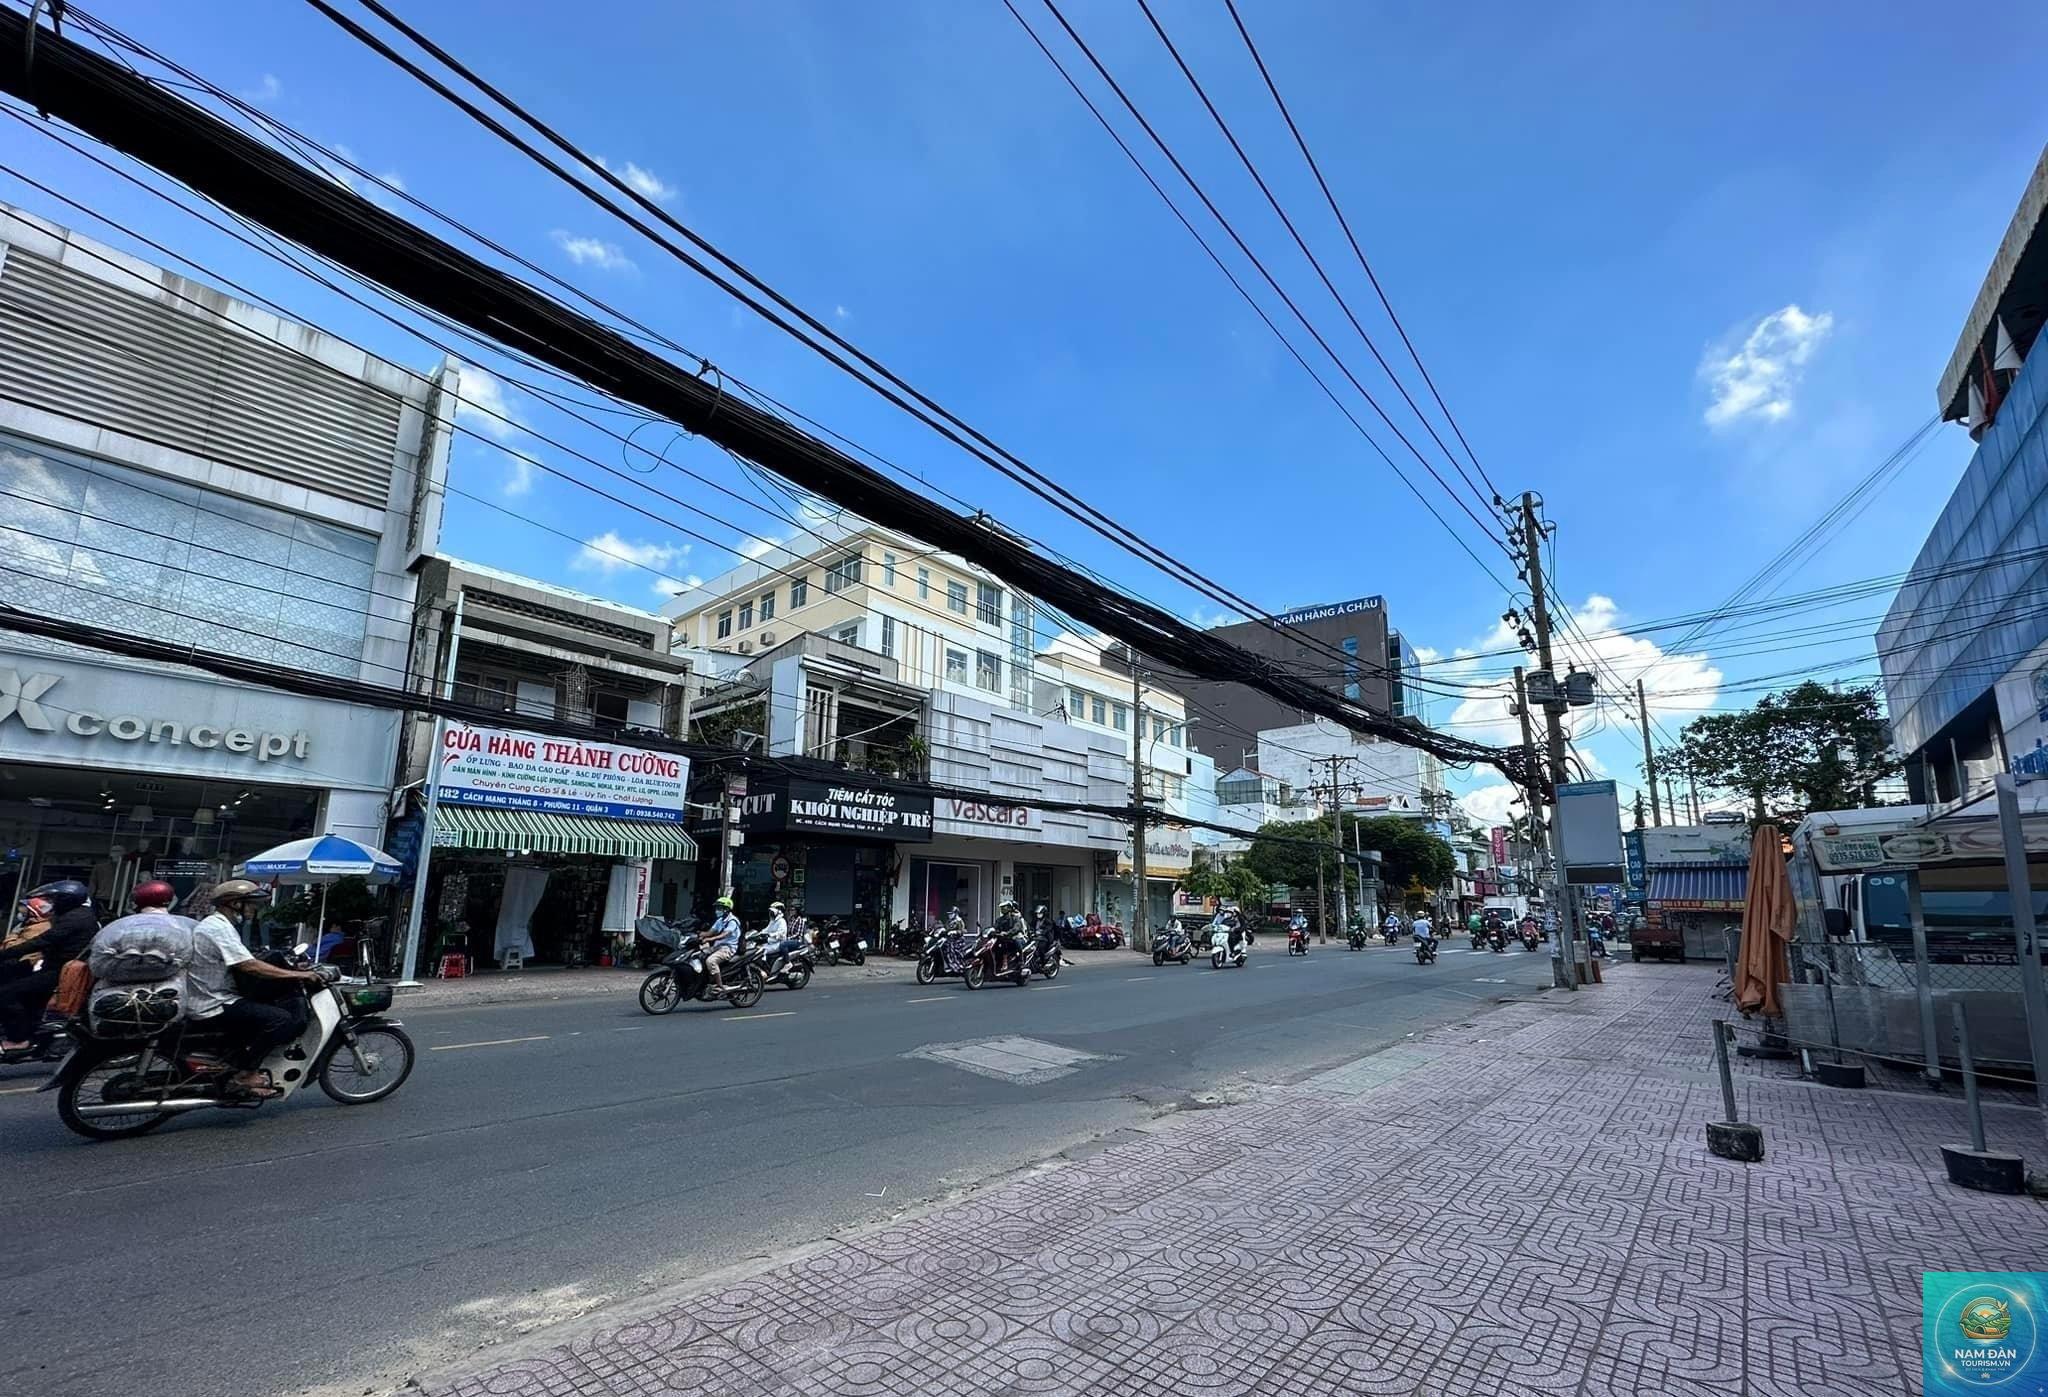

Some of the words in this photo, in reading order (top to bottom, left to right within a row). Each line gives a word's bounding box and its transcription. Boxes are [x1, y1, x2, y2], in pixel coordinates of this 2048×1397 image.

[1305, 607, 1335, 621] HÀNG
[1337, 604, 1345, 616] Á
[1346, 599, 1379, 613] CHÂU
[66, 710, 311, 762] concept
[444, 724, 481, 752] CỬA
[487, 733, 537, 760] HÀNG
[543, 741, 614, 769] THÀNH
[618, 752, 680, 778] CƯỜNG
[508, 761, 524, 770] BAO
[525, 764, 537, 772] DA
[538, 764, 553, 774] CAO
[555, 765, 570, 776] CẤP
[645, 778, 681, 789] BLUETOOTH
[462, 791, 484, 802] CÁCH
[485, 795, 506, 805] MẠNG
[508, 796, 531, 807] THÁNG
[472, 778, 507, 789] Chuyên
[508, 783, 531, 793] Cung
[585, 791, 594, 799] Uy
[828, 787, 854, 802] TIỆM
[855, 788, 875, 805] CẮT
[876, 792, 895, 807] TÓC
[790, 798, 837, 818] KHỞI
[840, 807, 898, 826] NGHIỆP
[901, 810, 932, 828] TRẺ
